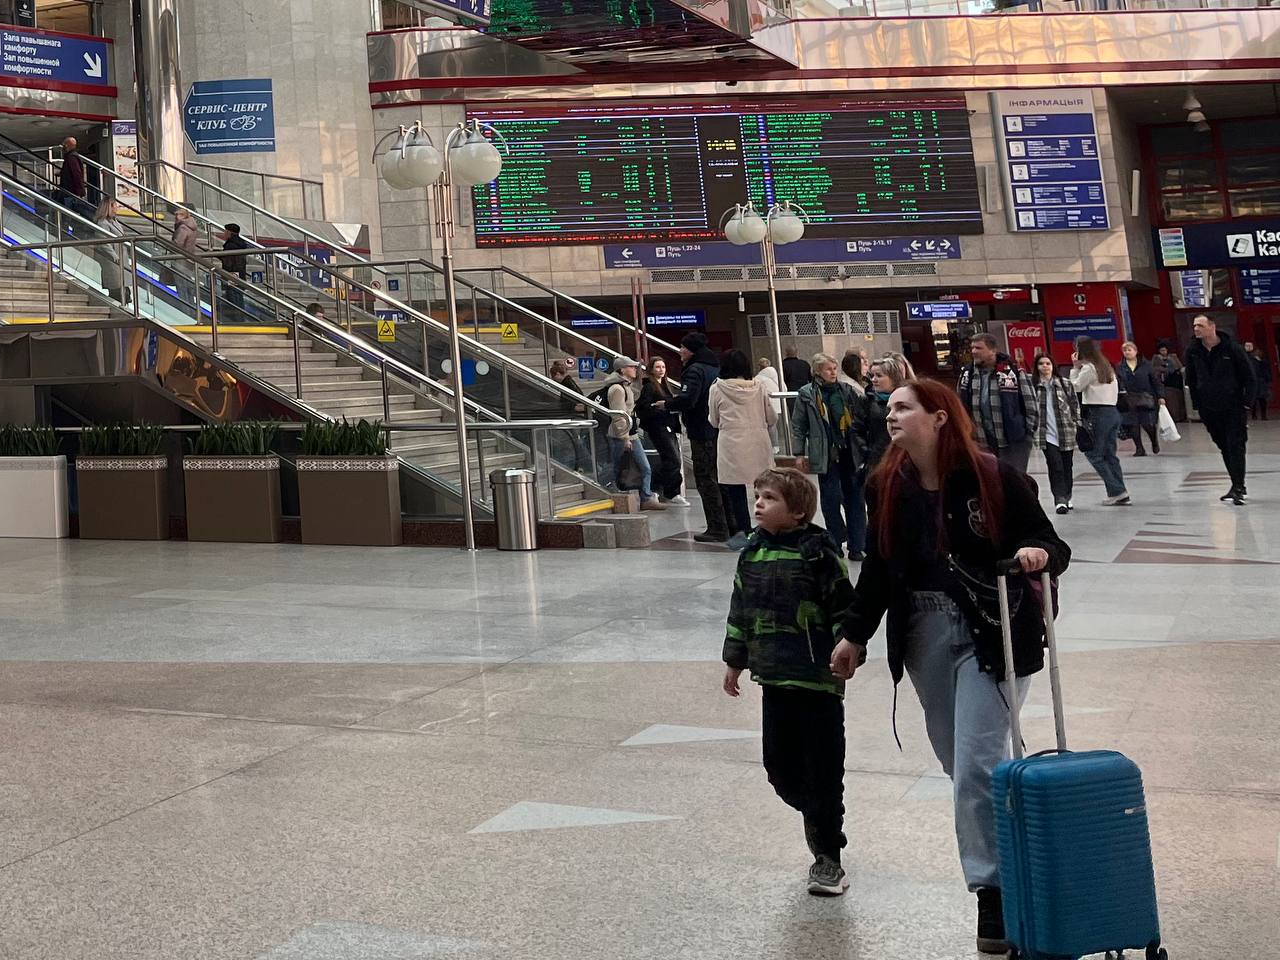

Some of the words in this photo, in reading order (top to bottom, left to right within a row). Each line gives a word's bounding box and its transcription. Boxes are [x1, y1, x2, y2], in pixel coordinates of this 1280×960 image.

[4, 33, 20, 42] Зала
[20, 35, 61, 48] павышанага
[4, 43, 37, 55] камфорту
[3, 53, 17, 62] Зал
[18, 56, 60, 67] повышенной
[4, 63, 52, 76] комфортности
[188, 103, 268, 115] СЕРВИС-ЦЕНТР
